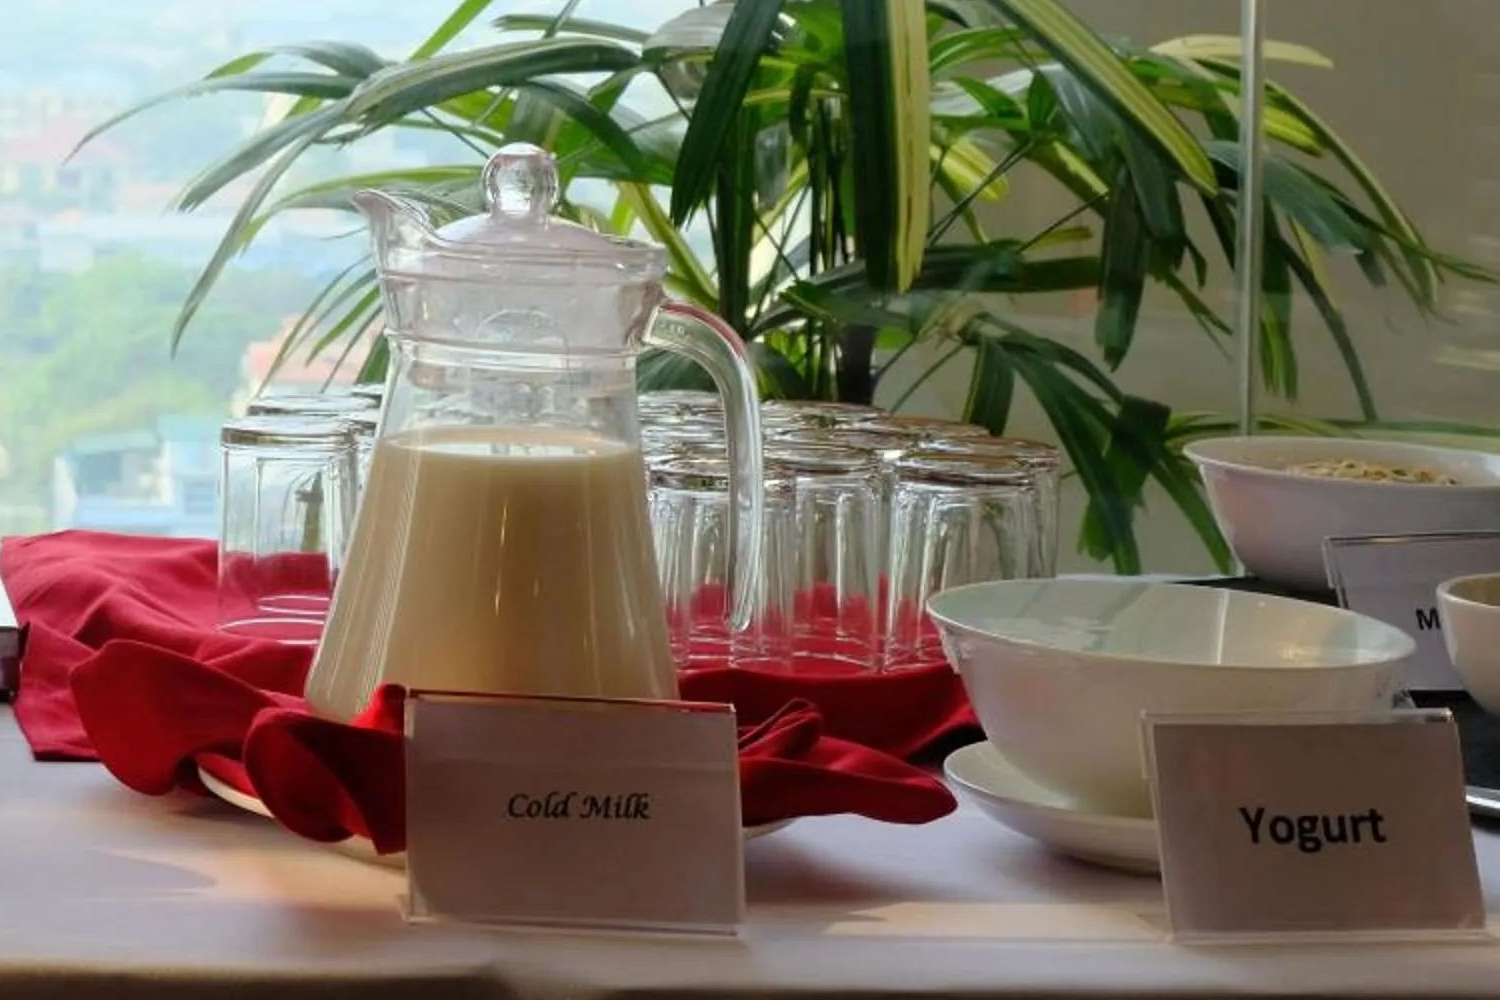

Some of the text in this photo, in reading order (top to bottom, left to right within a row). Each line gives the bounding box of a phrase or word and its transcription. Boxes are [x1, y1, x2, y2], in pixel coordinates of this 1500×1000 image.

[508, 792, 650, 819] Cold Milk
[1238, 807, 1387, 853] Yogurt
